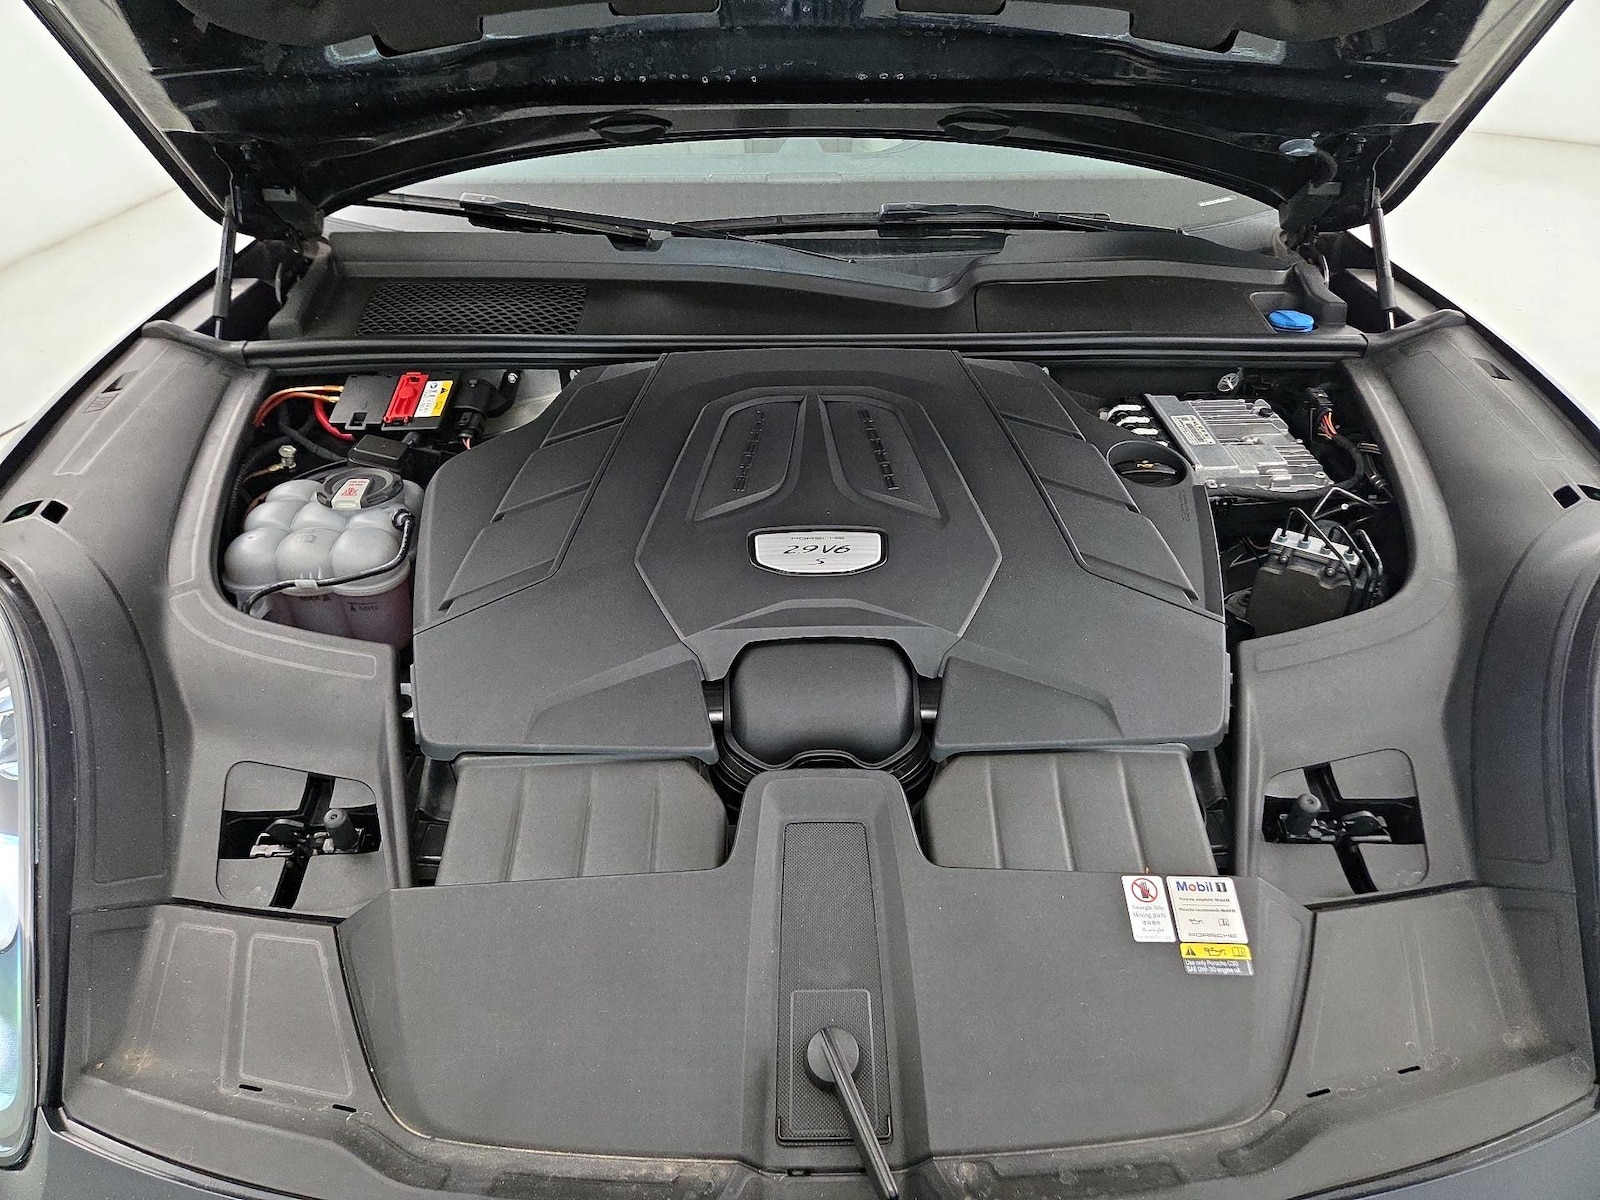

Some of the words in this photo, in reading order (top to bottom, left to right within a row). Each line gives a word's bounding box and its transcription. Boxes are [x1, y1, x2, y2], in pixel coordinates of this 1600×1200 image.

[857, 409, 900, 491] PORSCHE
[1175, 881, 1213, 893] Mobil
[1215, 882, 1228, 893] 1
